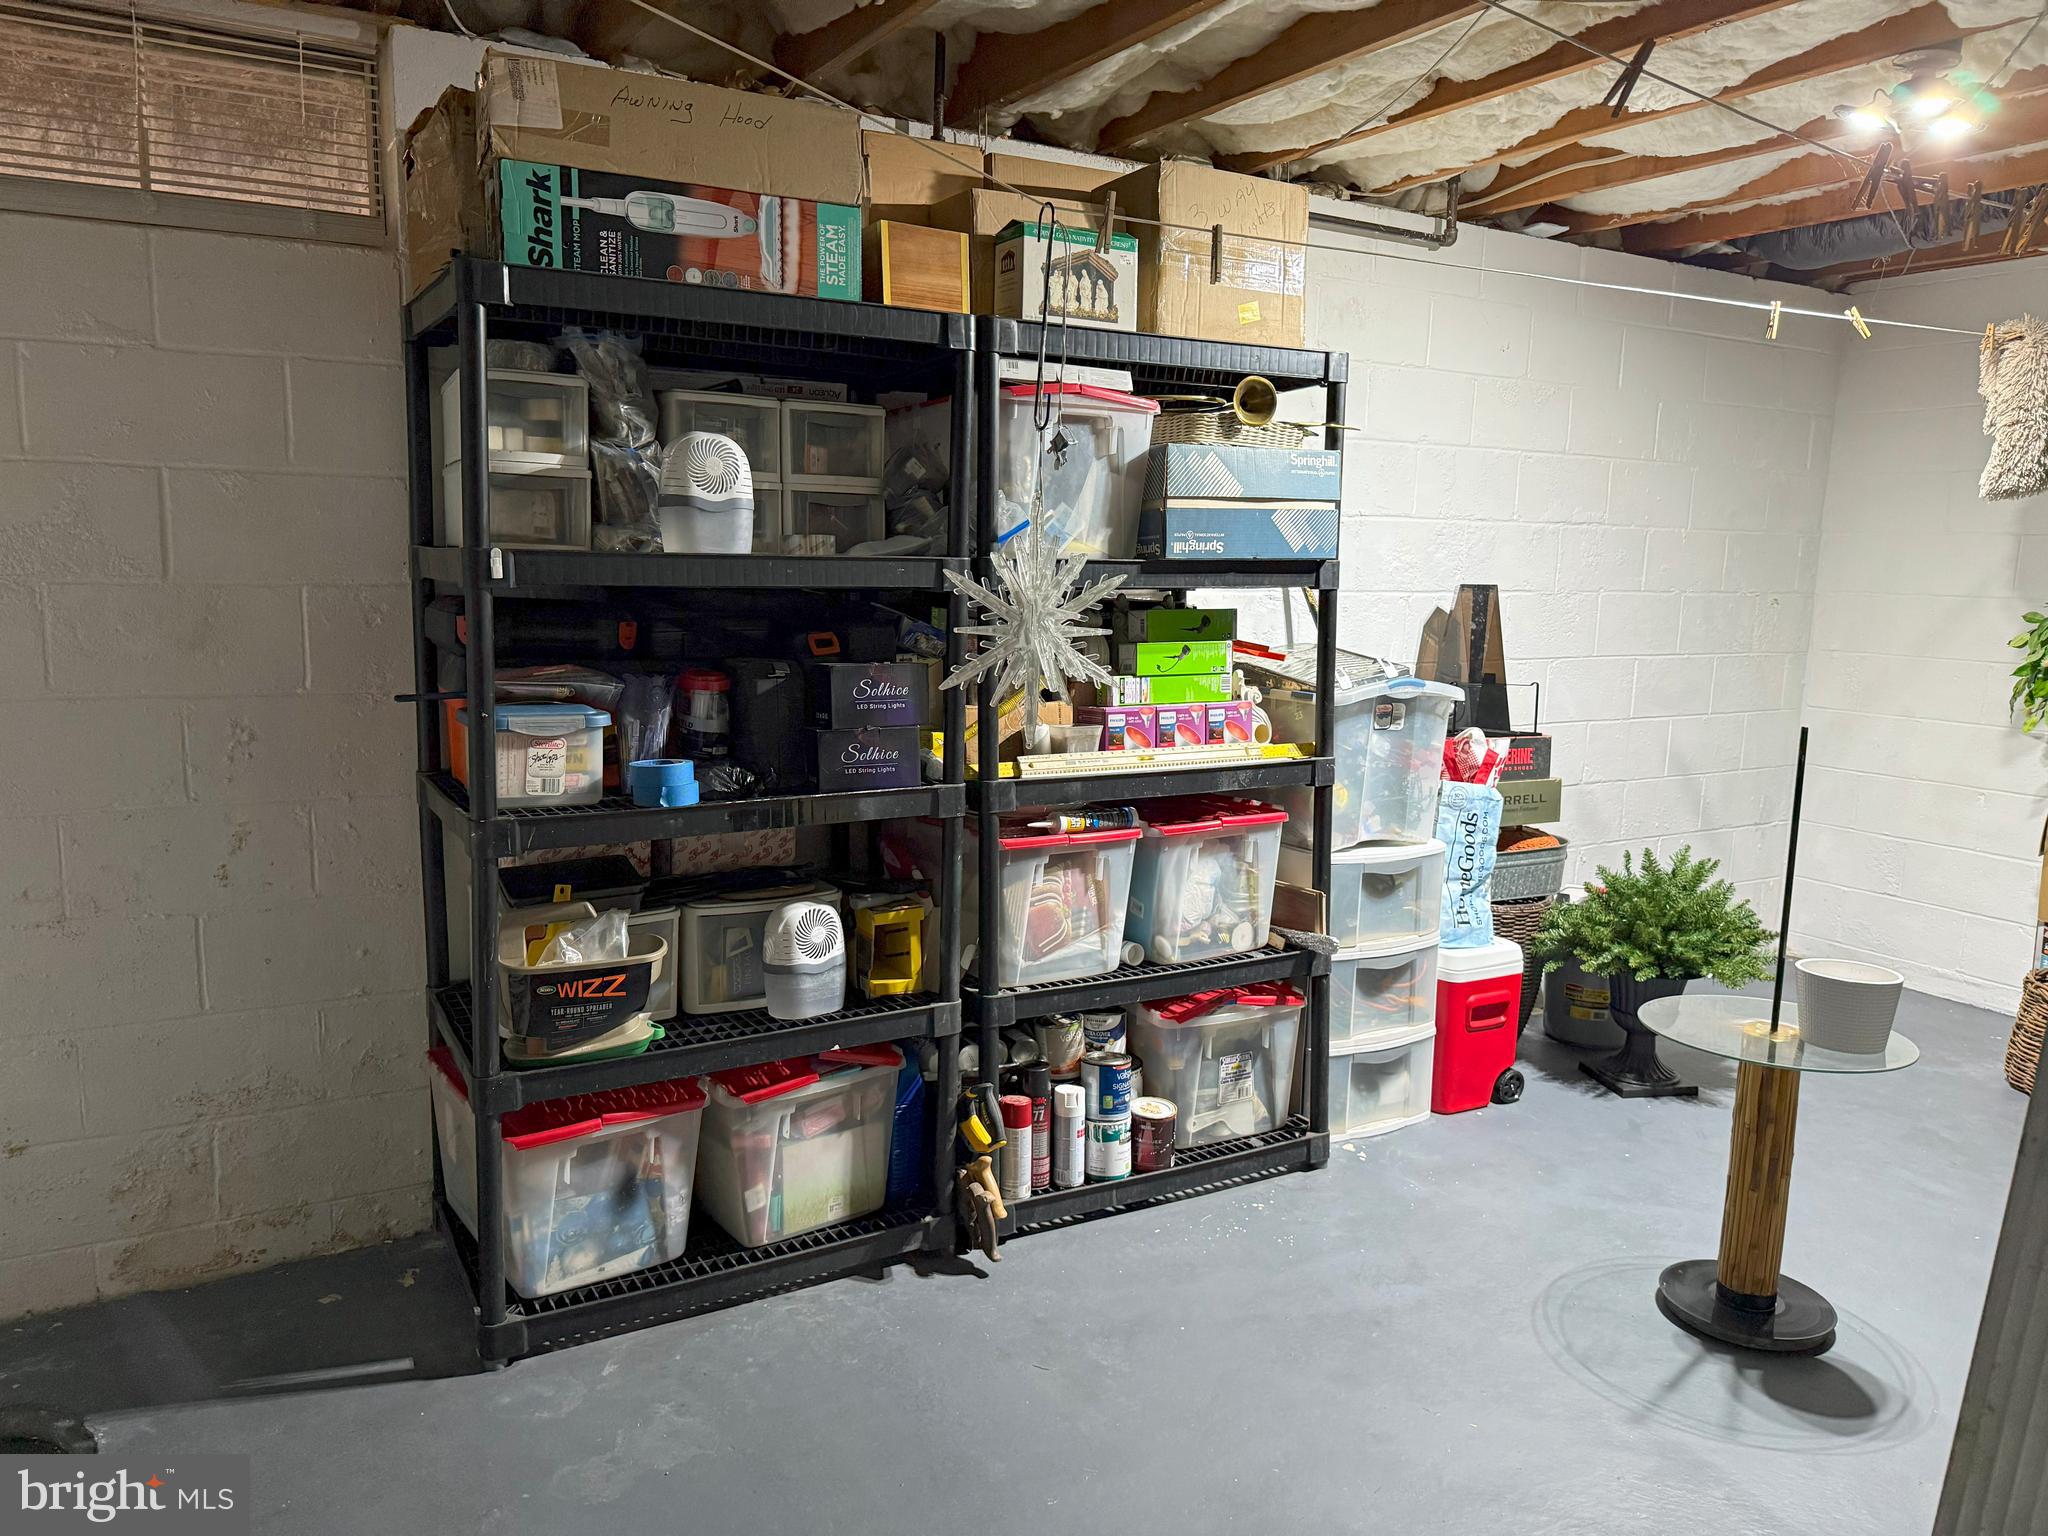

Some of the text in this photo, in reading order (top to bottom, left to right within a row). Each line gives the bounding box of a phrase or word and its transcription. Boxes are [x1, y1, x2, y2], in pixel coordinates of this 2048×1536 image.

[719, 102, 773, 130] Hood
[525, 168, 554, 268] Shark
[572, 220, 581, 241] MOP
[599, 230, 608, 238] &
[819, 223, 826, 235] OF
[826, 224, 838, 286] STEAM
[838, 255, 846, 286] MADE
[853, 678, 910, 699] Solhice
[841, 743, 900, 763] Solhice
[557, 974, 627, 998] WIZZ
[551, 1006, 585, 1016] YEAR-ROUND
[586, 1003, 613, 1012] SPREADER
[1033, 1110, 1045, 1121] 77
